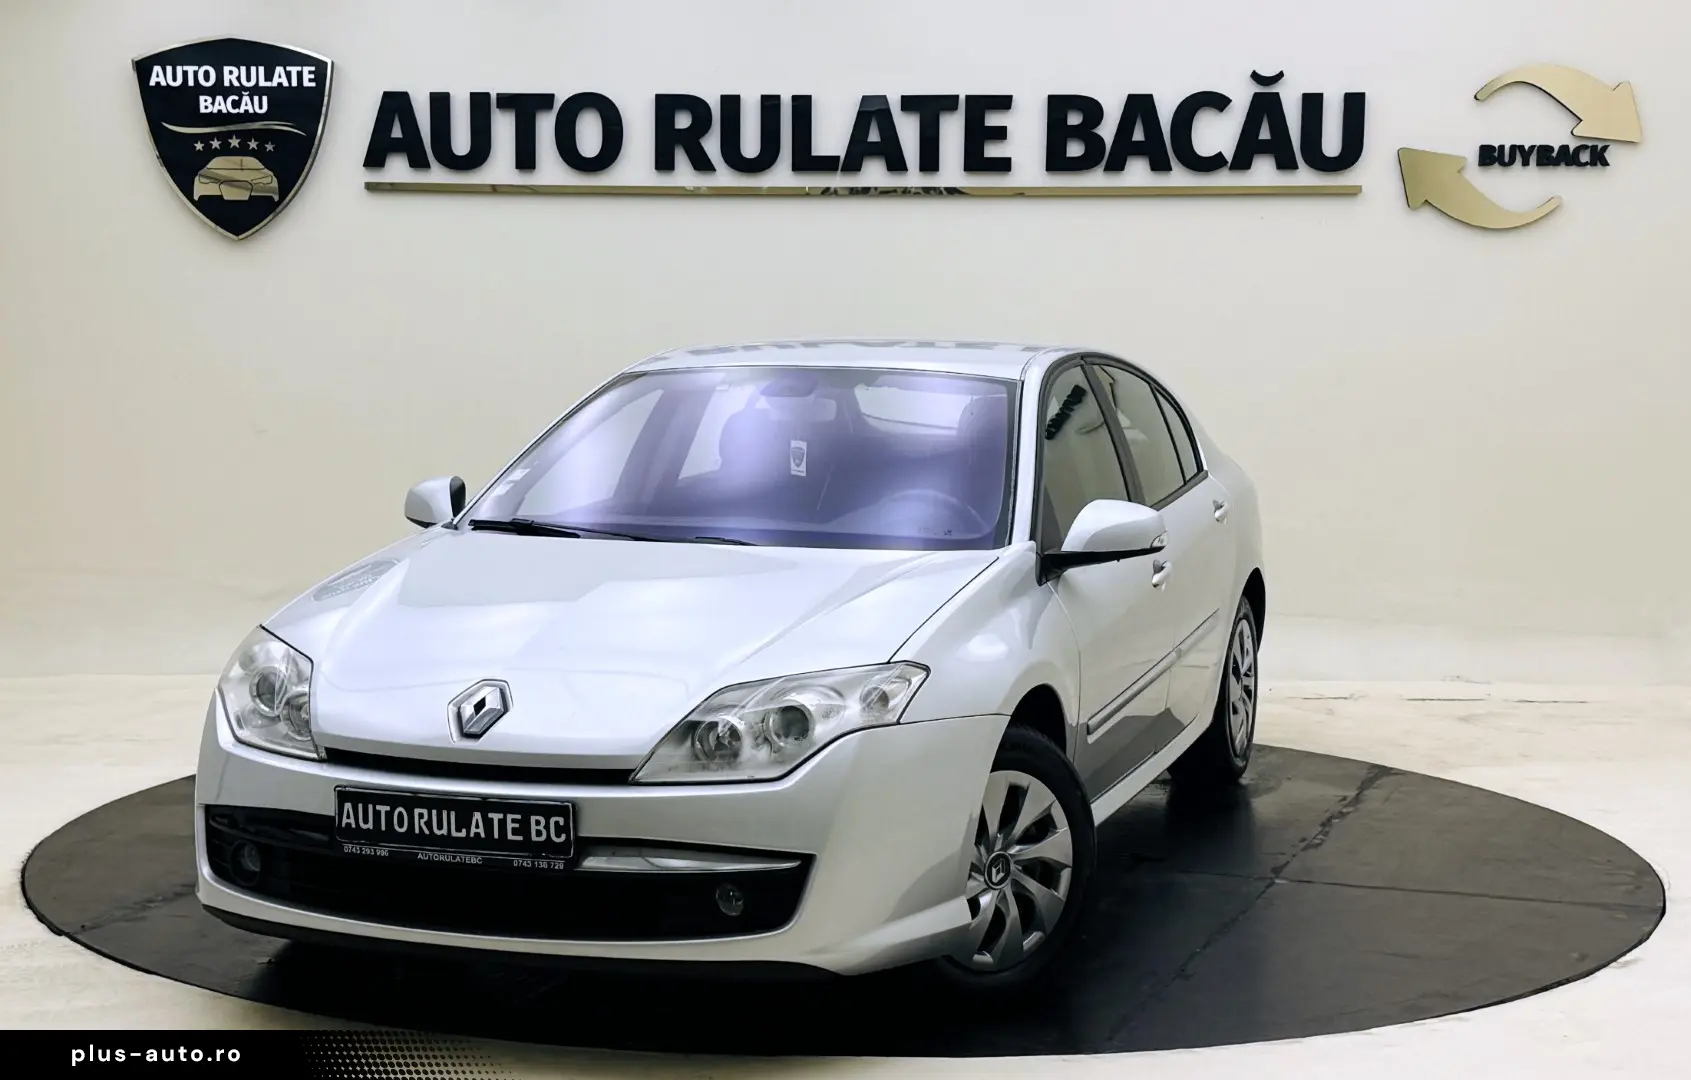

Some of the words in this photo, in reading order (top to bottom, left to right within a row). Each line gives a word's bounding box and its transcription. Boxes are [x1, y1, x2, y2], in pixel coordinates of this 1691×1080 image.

[149, 65, 217, 87] AUTO
[223, 65, 316, 87] RULATE
[198, 91, 268, 114] BACĂU
[362, 91, 624, 173] AUTO
[654, 93, 1014, 174] RULATE
[1045, 69, 1366, 173] BACĂU
[1477, 144, 1610, 167] BUYBACK
[341, 802, 409, 833] AUTO
[414, 807, 524, 842] RULATE
[530, 815, 567, 843] BC
[417, 852, 483, 865] AUTORULATEBC
